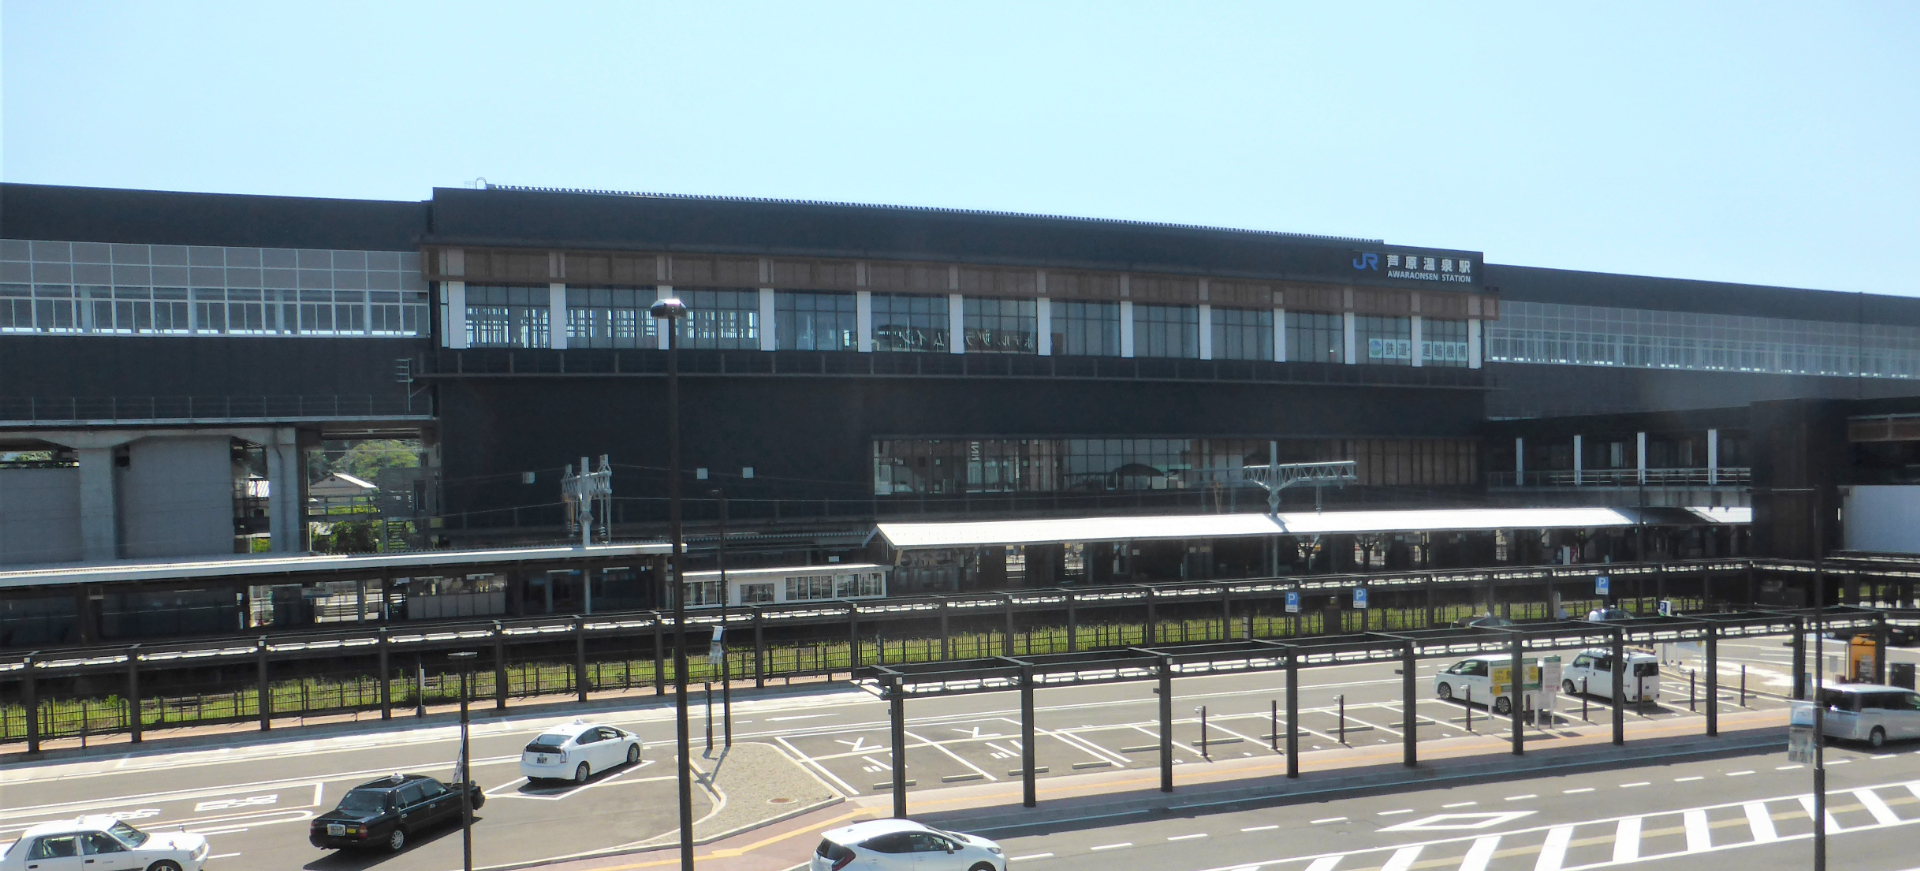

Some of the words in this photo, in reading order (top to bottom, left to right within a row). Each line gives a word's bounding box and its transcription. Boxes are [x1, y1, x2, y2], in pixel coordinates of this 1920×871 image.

[1352, 253, 1379, 271] JR
[1386, 254, 1471, 274] 芦原温泉駅
[1387, 270, 1439, 281] AWARAONSEN
[1441, 273, 1471, 283] STATION
[1598, 577, 1606, 587] P
[1287, 593, 1296, 604] P
[1355, 589, 1364, 600] P
